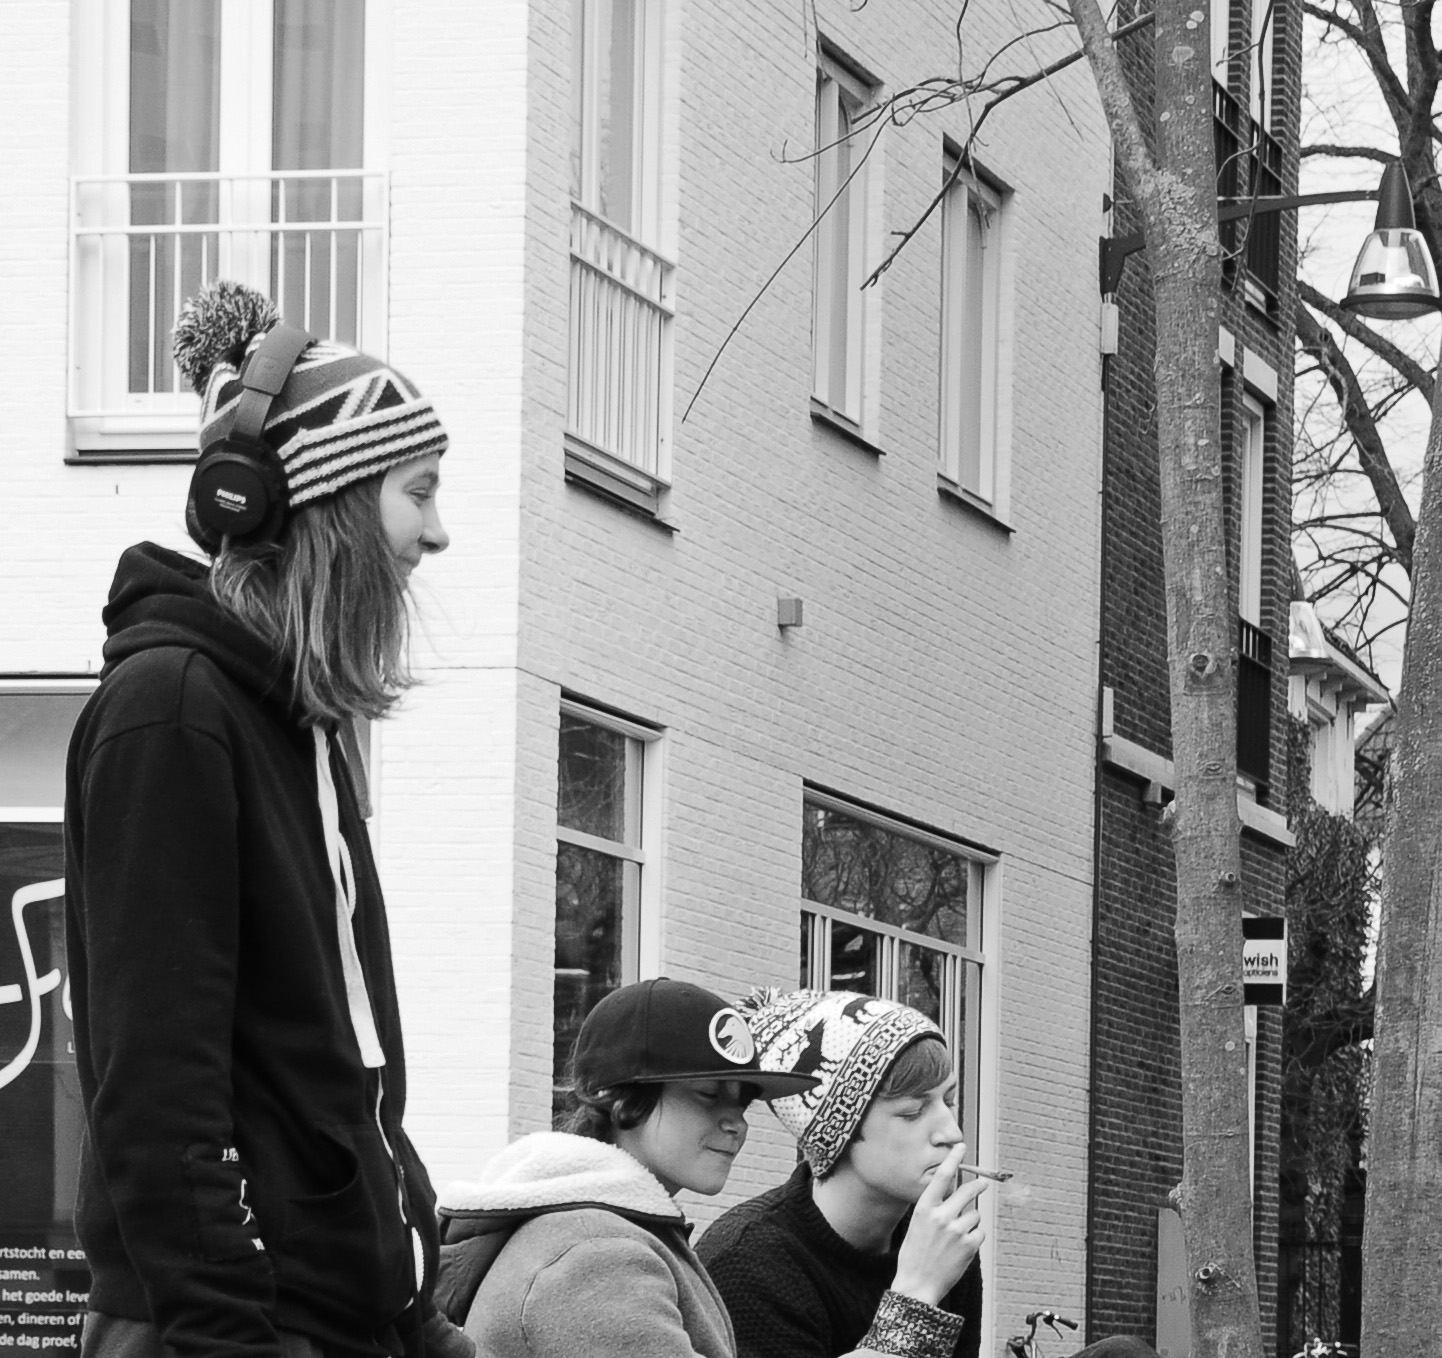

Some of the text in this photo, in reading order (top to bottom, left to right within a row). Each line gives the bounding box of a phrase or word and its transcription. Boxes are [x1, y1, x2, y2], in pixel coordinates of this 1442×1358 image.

[1243, 952, 1279, 968] wish
[48, 1249, 65, 1260] en
[2, 1288, 23, 1302] het
[25, 1290, 64, 1304] goede
[17, 1312, 65, 1326] dineren
[67, 1313, 81, 1325] of
[0, 1333, 78, 1349] de dag proef,
